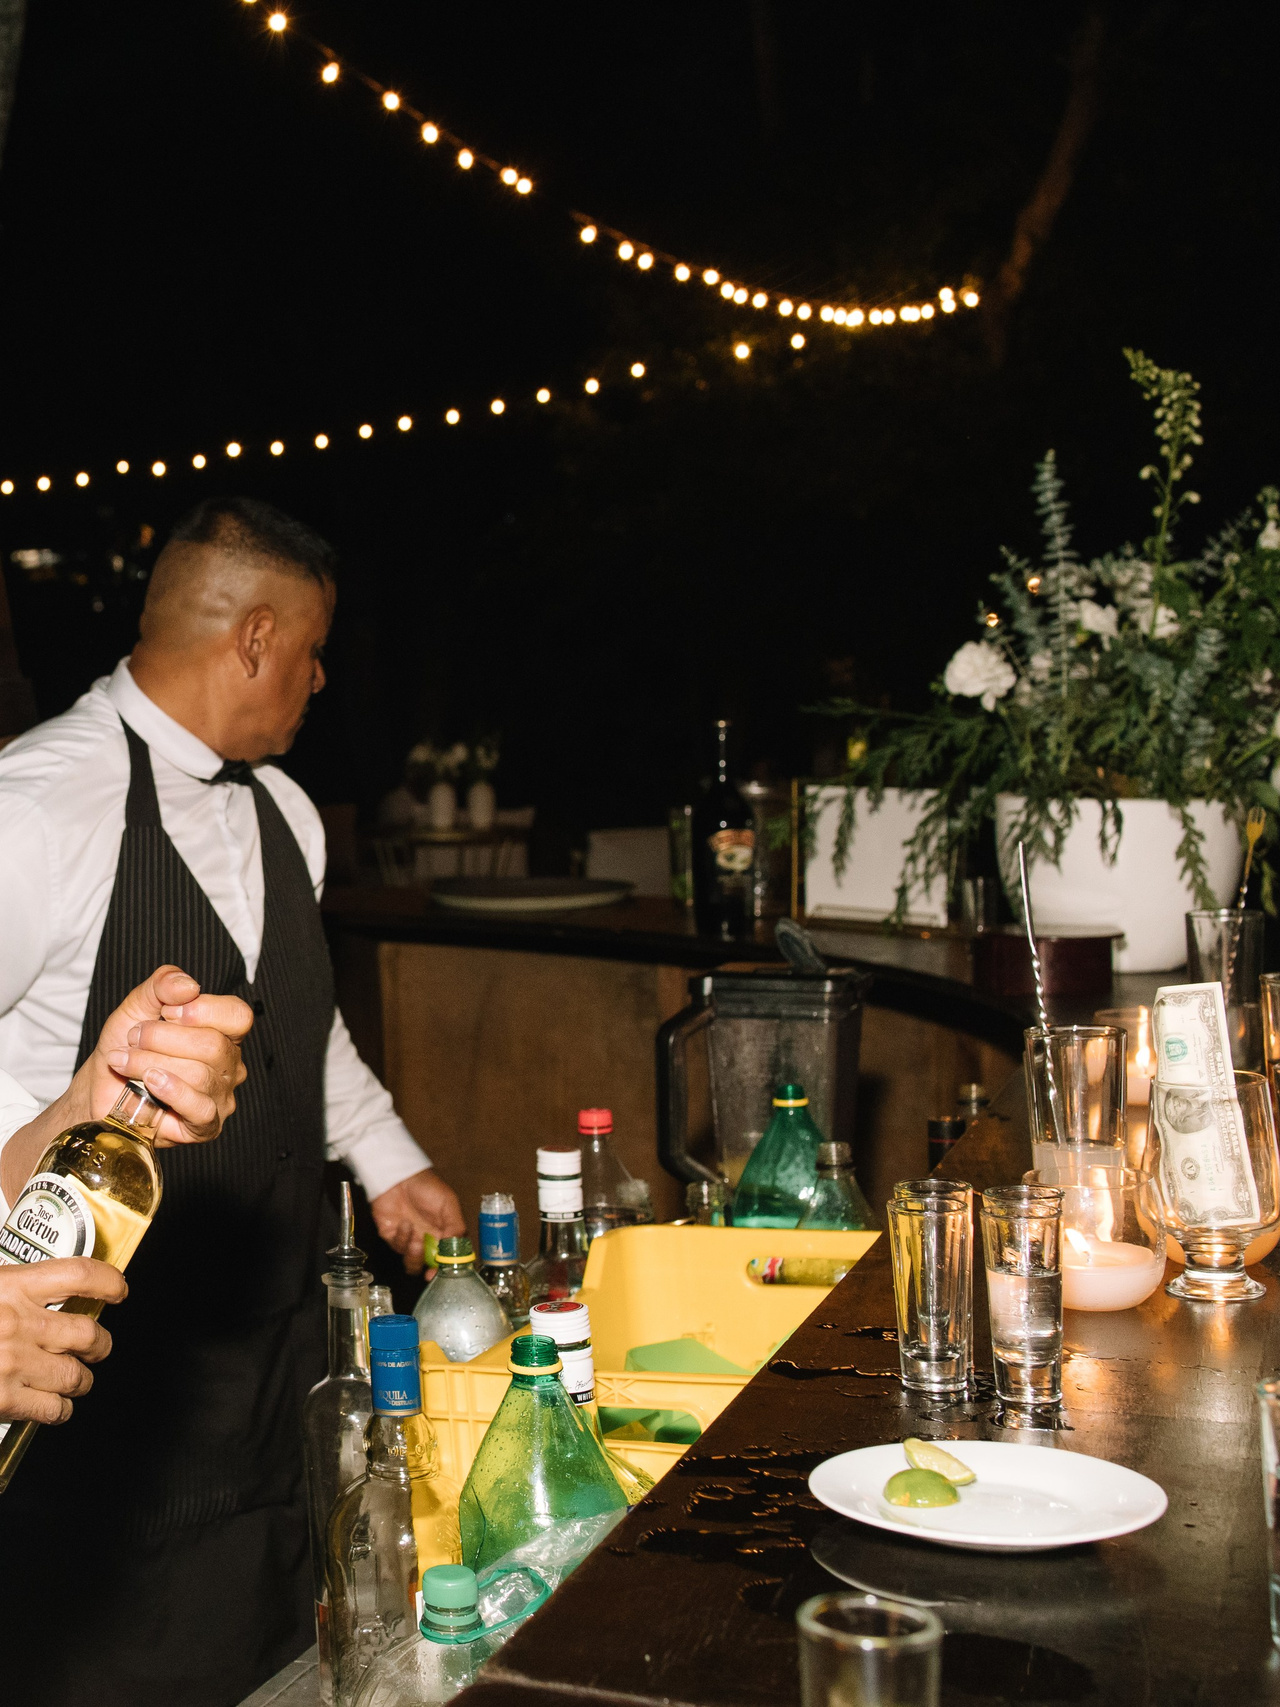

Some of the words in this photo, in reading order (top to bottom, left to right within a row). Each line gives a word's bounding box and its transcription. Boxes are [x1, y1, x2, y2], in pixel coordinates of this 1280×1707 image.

[1215, 1051, 1234, 1122] DOLLARS
[1228, 1123, 1241, 1157] TWO
[50, 1184, 62, 1195] DE
[16, 1208, 60, 1244] Cuervo
[34, 1204, 54, 1222] Jose
[577, 1392, 593, 1402] WHITE
